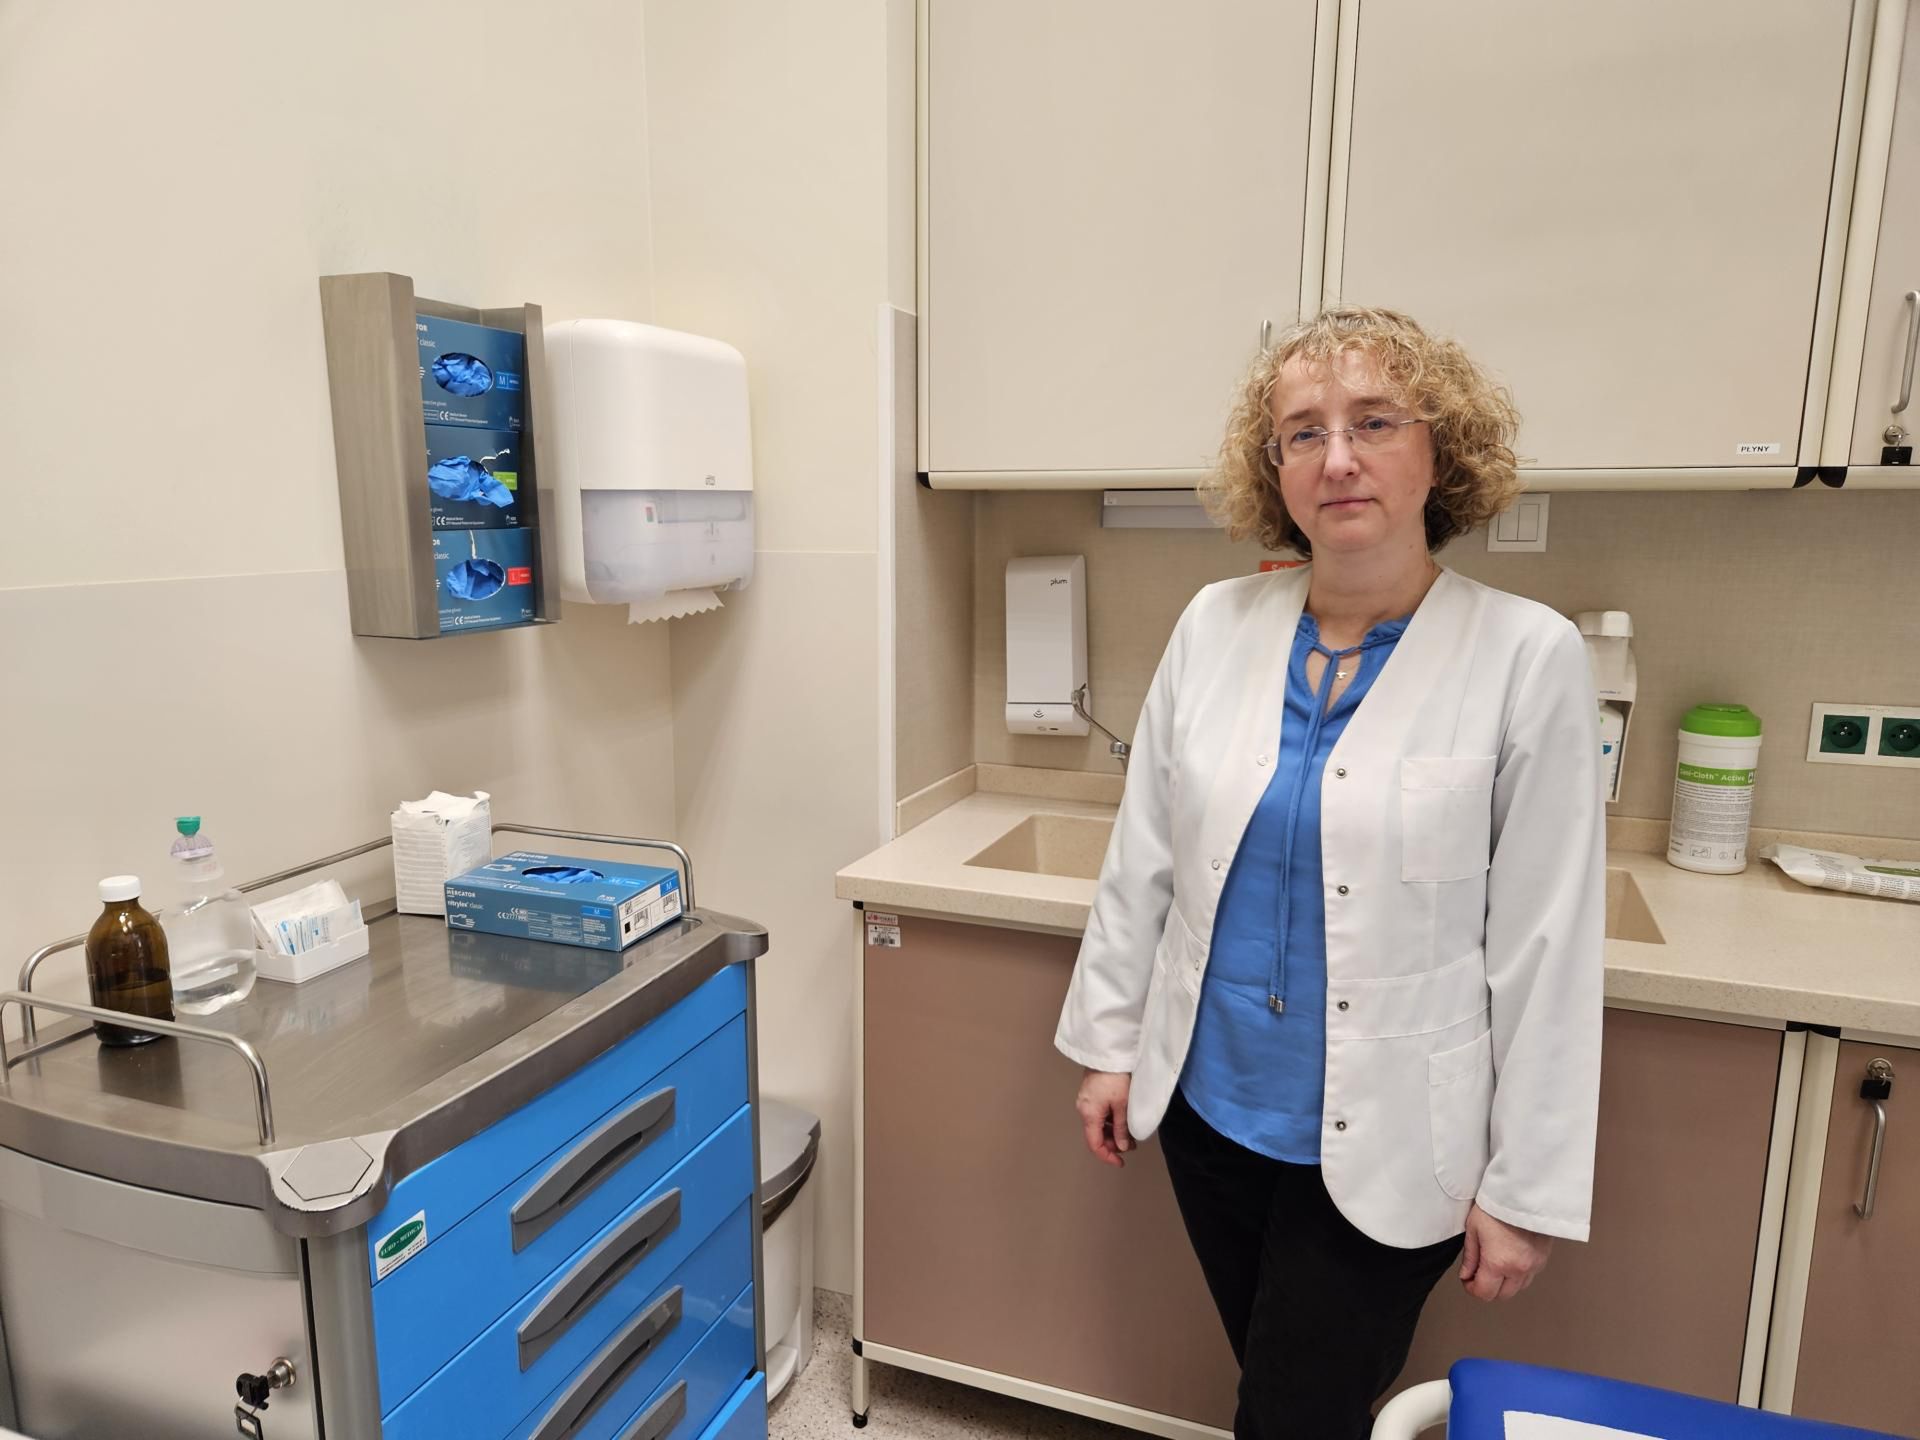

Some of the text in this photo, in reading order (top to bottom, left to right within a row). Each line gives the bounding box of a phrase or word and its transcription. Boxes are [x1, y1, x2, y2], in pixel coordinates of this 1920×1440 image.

[419, 339, 436, 348] classic
[499, 375, 506, 385] M
[434, 552, 450, 560] classic
[1050, 577, 1068, 586] plum
[1721, 773, 1746, 782] Active
[446, 889, 476, 898] MERCATOR
[447, 900, 468, 909] nitrylex
